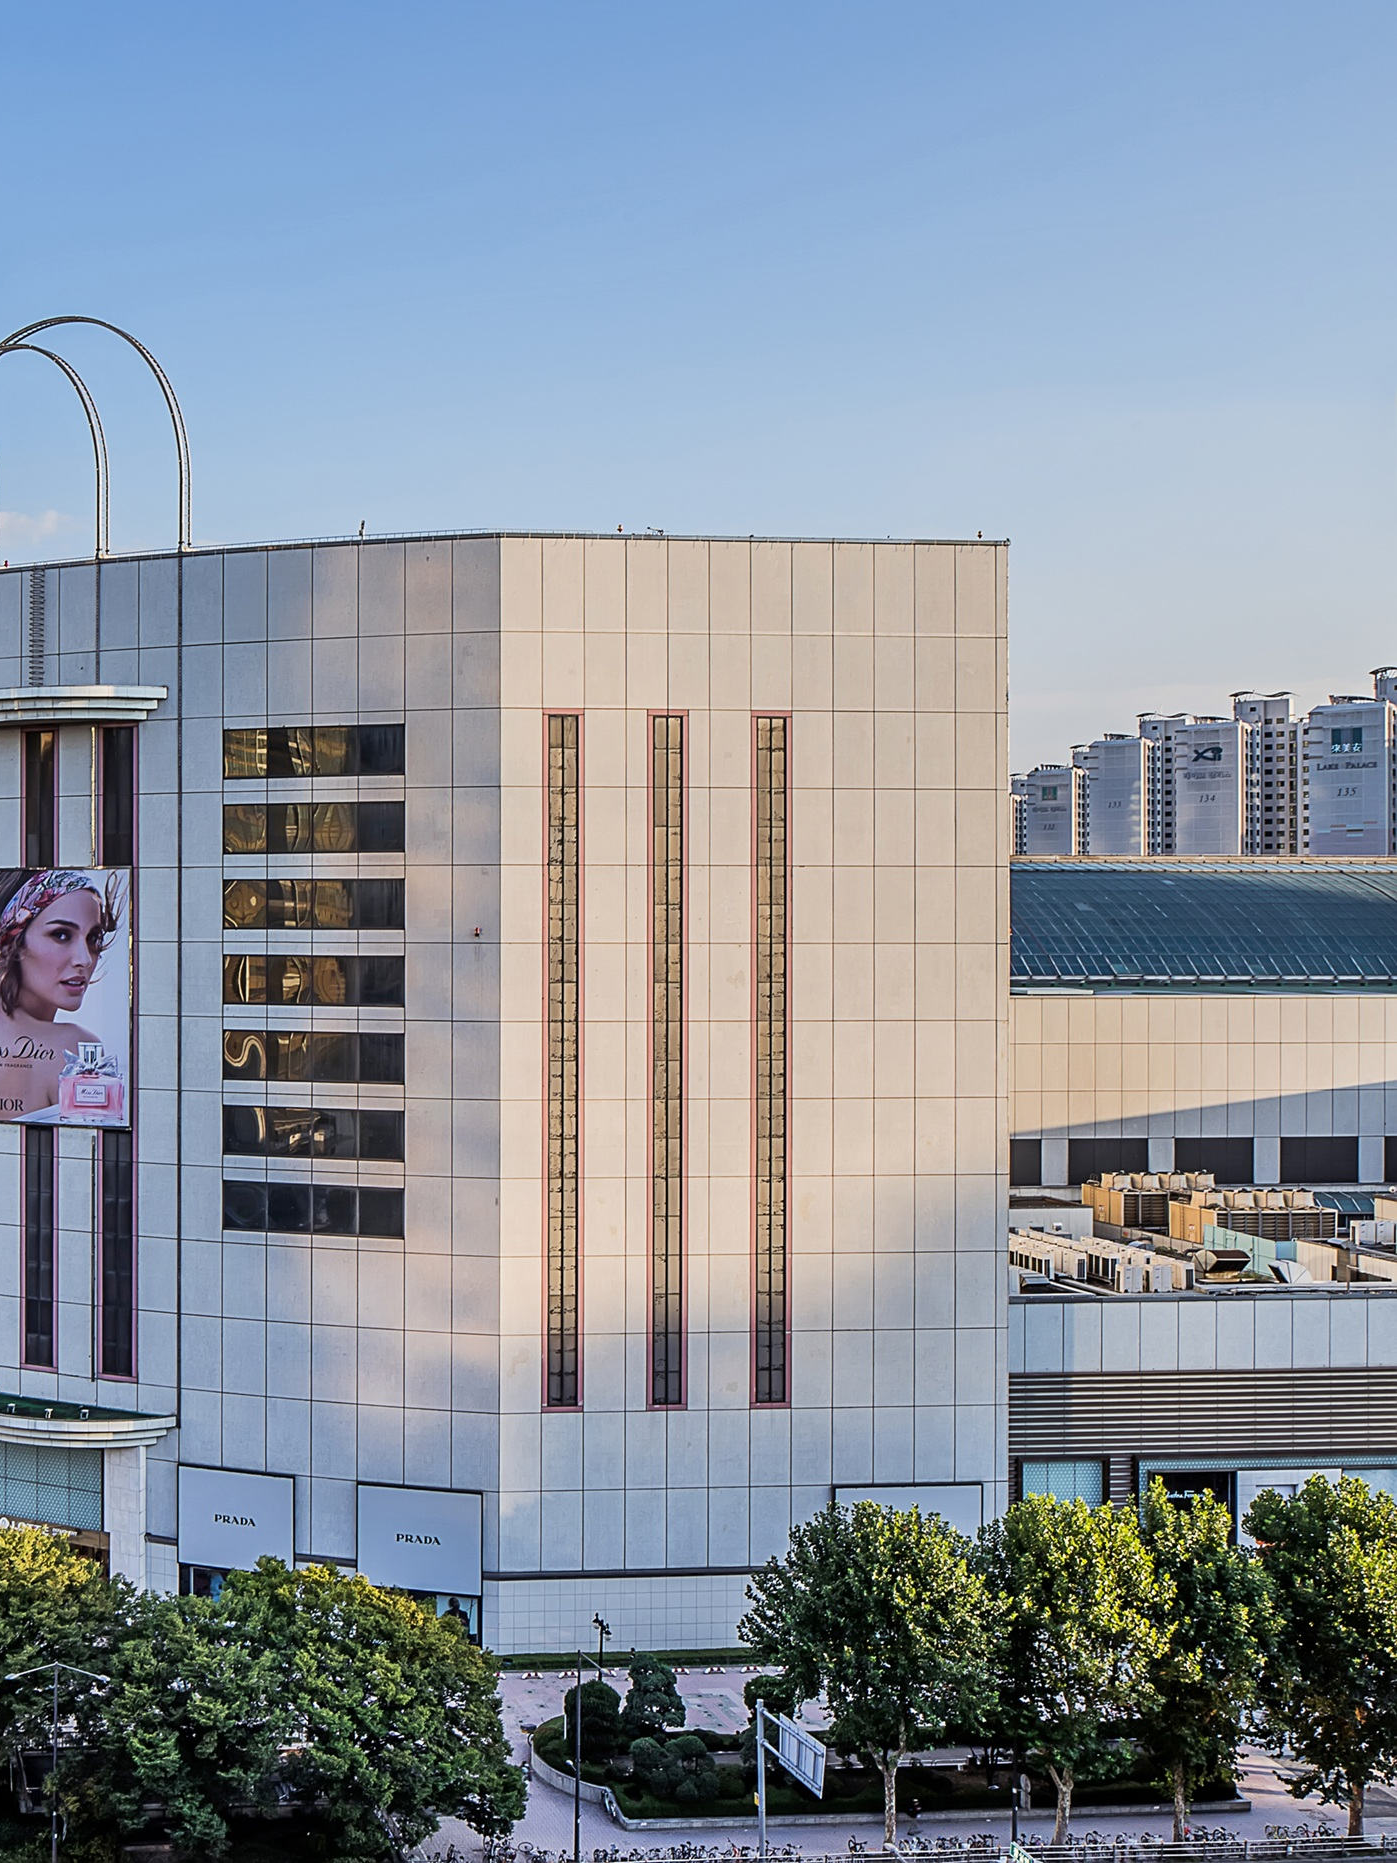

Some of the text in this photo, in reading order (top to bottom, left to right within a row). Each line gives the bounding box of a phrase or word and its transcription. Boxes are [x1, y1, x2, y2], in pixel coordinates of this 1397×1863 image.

[1316, 761, 1378, 771] LAKE PALACE
[1337, 786, 1358, 797] 135
[1199, 794, 1216, 803] 134
[1107, 801, 1122, 809] 133
[12, 1035, 57, 1061] Dior
[214, 1514, 256, 1527] PRADA
[396, 1533, 441, 1546] PRADA
